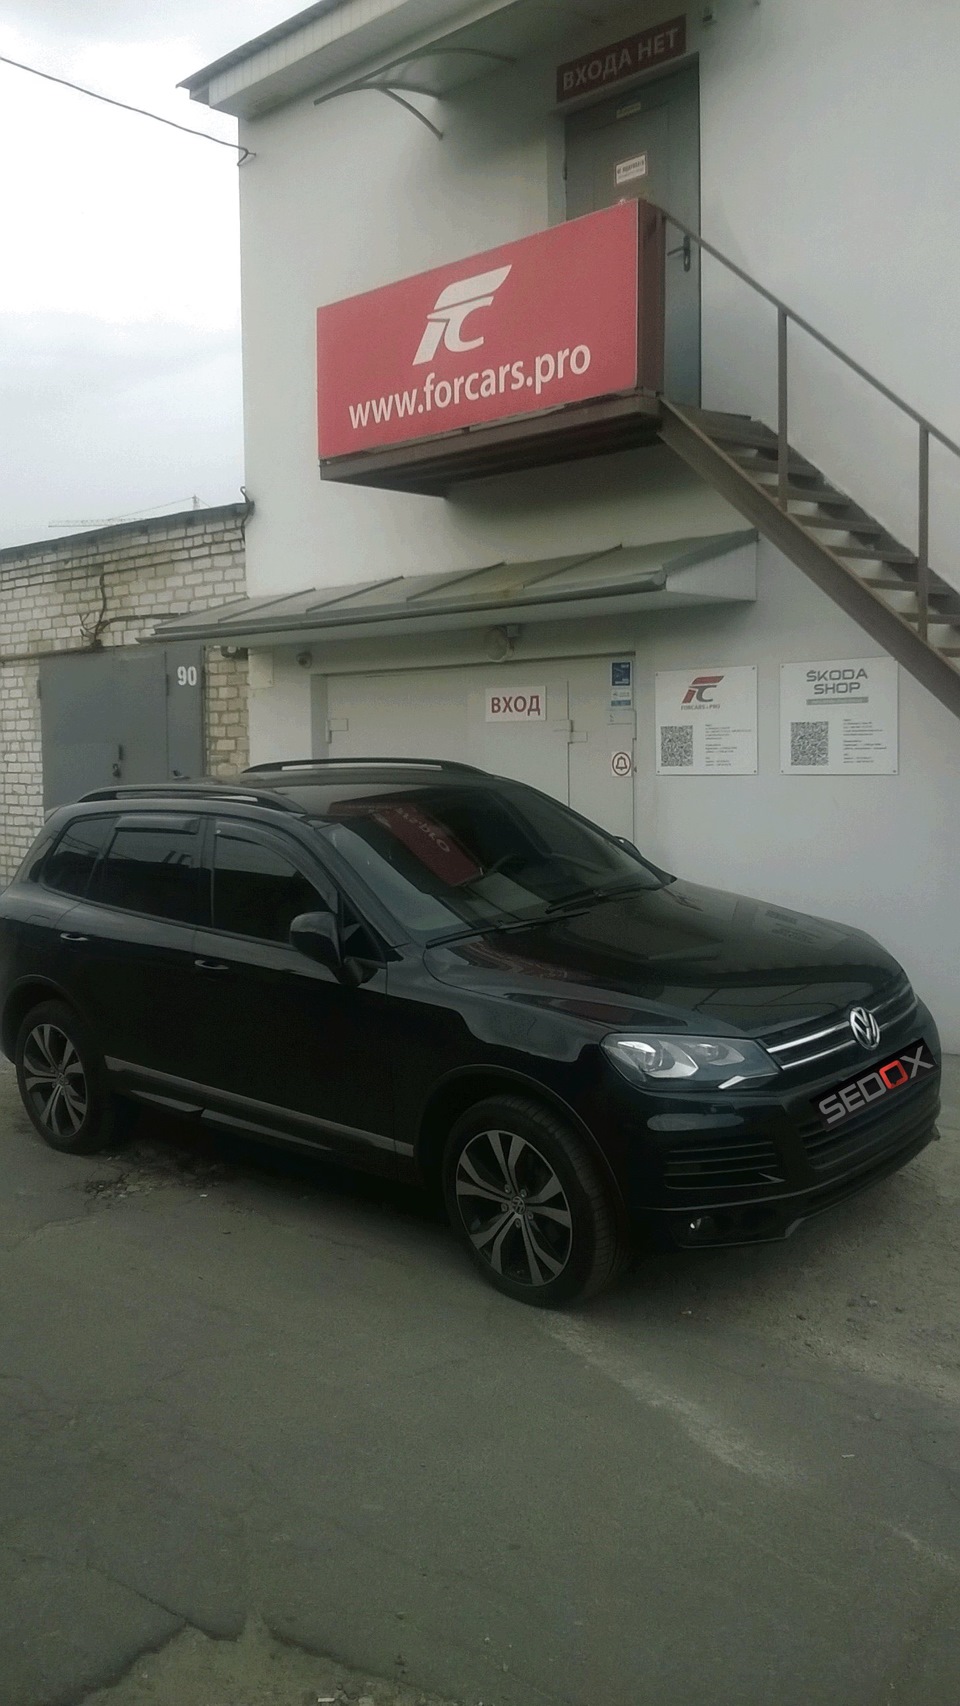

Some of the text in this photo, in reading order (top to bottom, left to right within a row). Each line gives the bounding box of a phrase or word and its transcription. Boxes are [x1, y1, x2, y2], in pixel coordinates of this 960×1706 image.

[563, 27, 679, 91] ВХОДА НЕТ
[349, 344, 591, 429] www.forcars.pro
[177, 666, 197, 686] 90
[813, 682, 860, 695] SHOP
[491, 695, 541, 716] ВХОД
